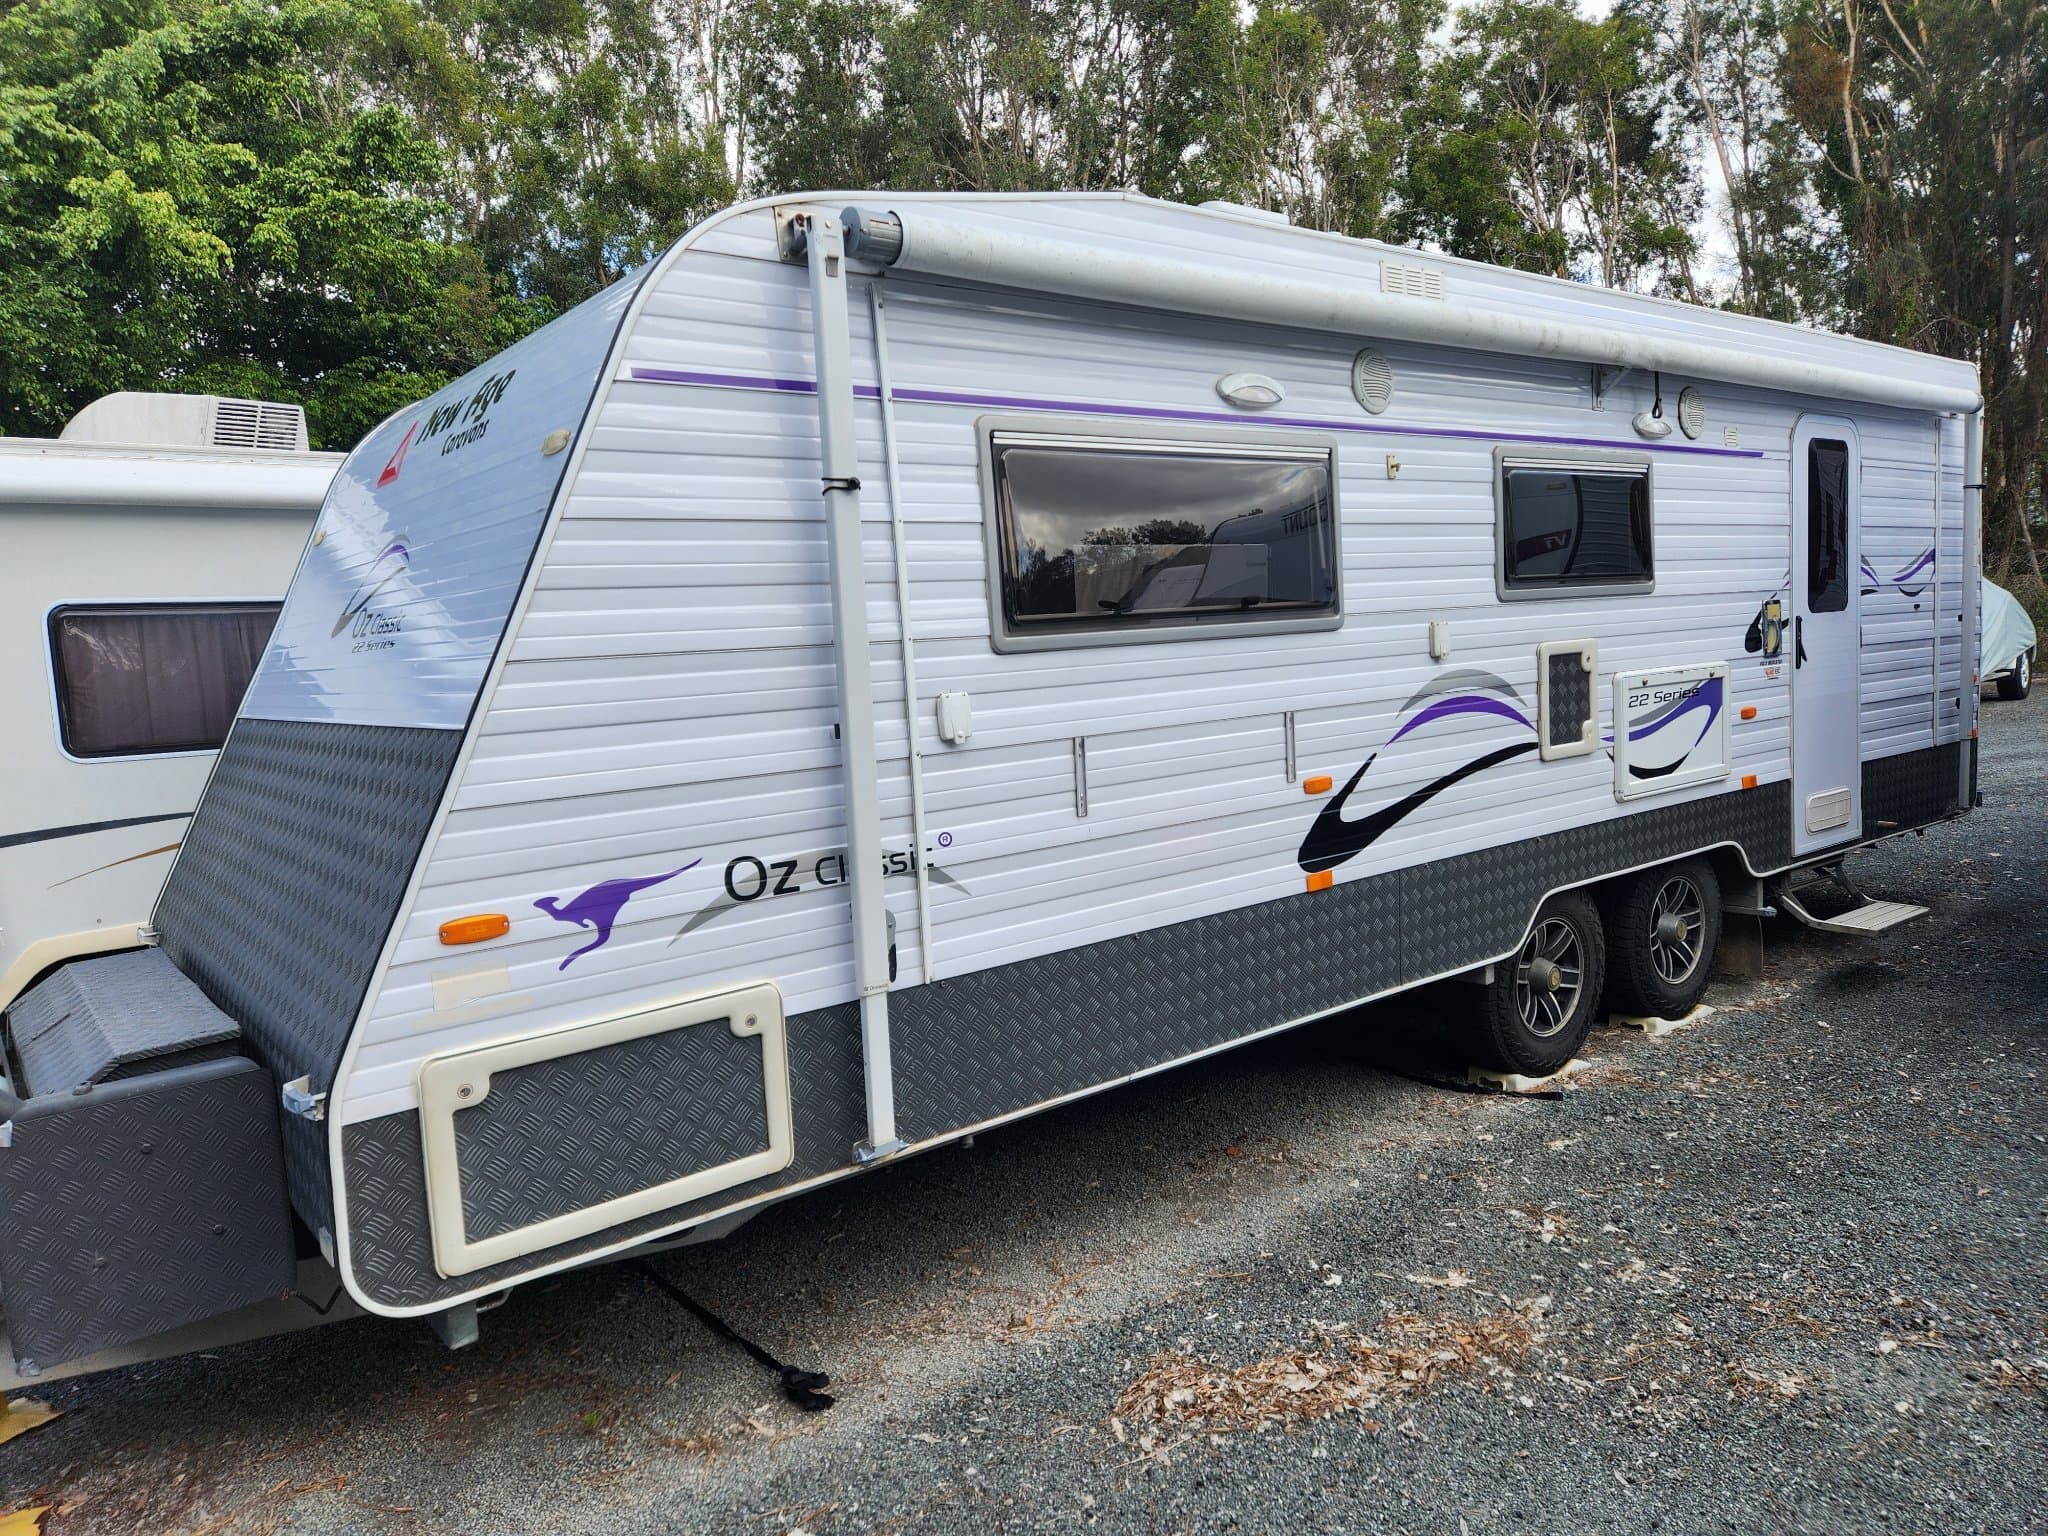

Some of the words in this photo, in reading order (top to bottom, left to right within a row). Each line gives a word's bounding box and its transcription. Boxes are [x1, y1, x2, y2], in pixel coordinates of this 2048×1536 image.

[415, 395, 469, 446] New
[462, 369, 516, 424] Age
[441, 418, 490, 456] Caravans
[352, 607, 373, 639] Oz
[371, 610, 406, 635] Classic
[1628, 694, 1650, 709] 22
[1653, 687, 1701, 704] Series
[725, 855, 801, 902] Oz
